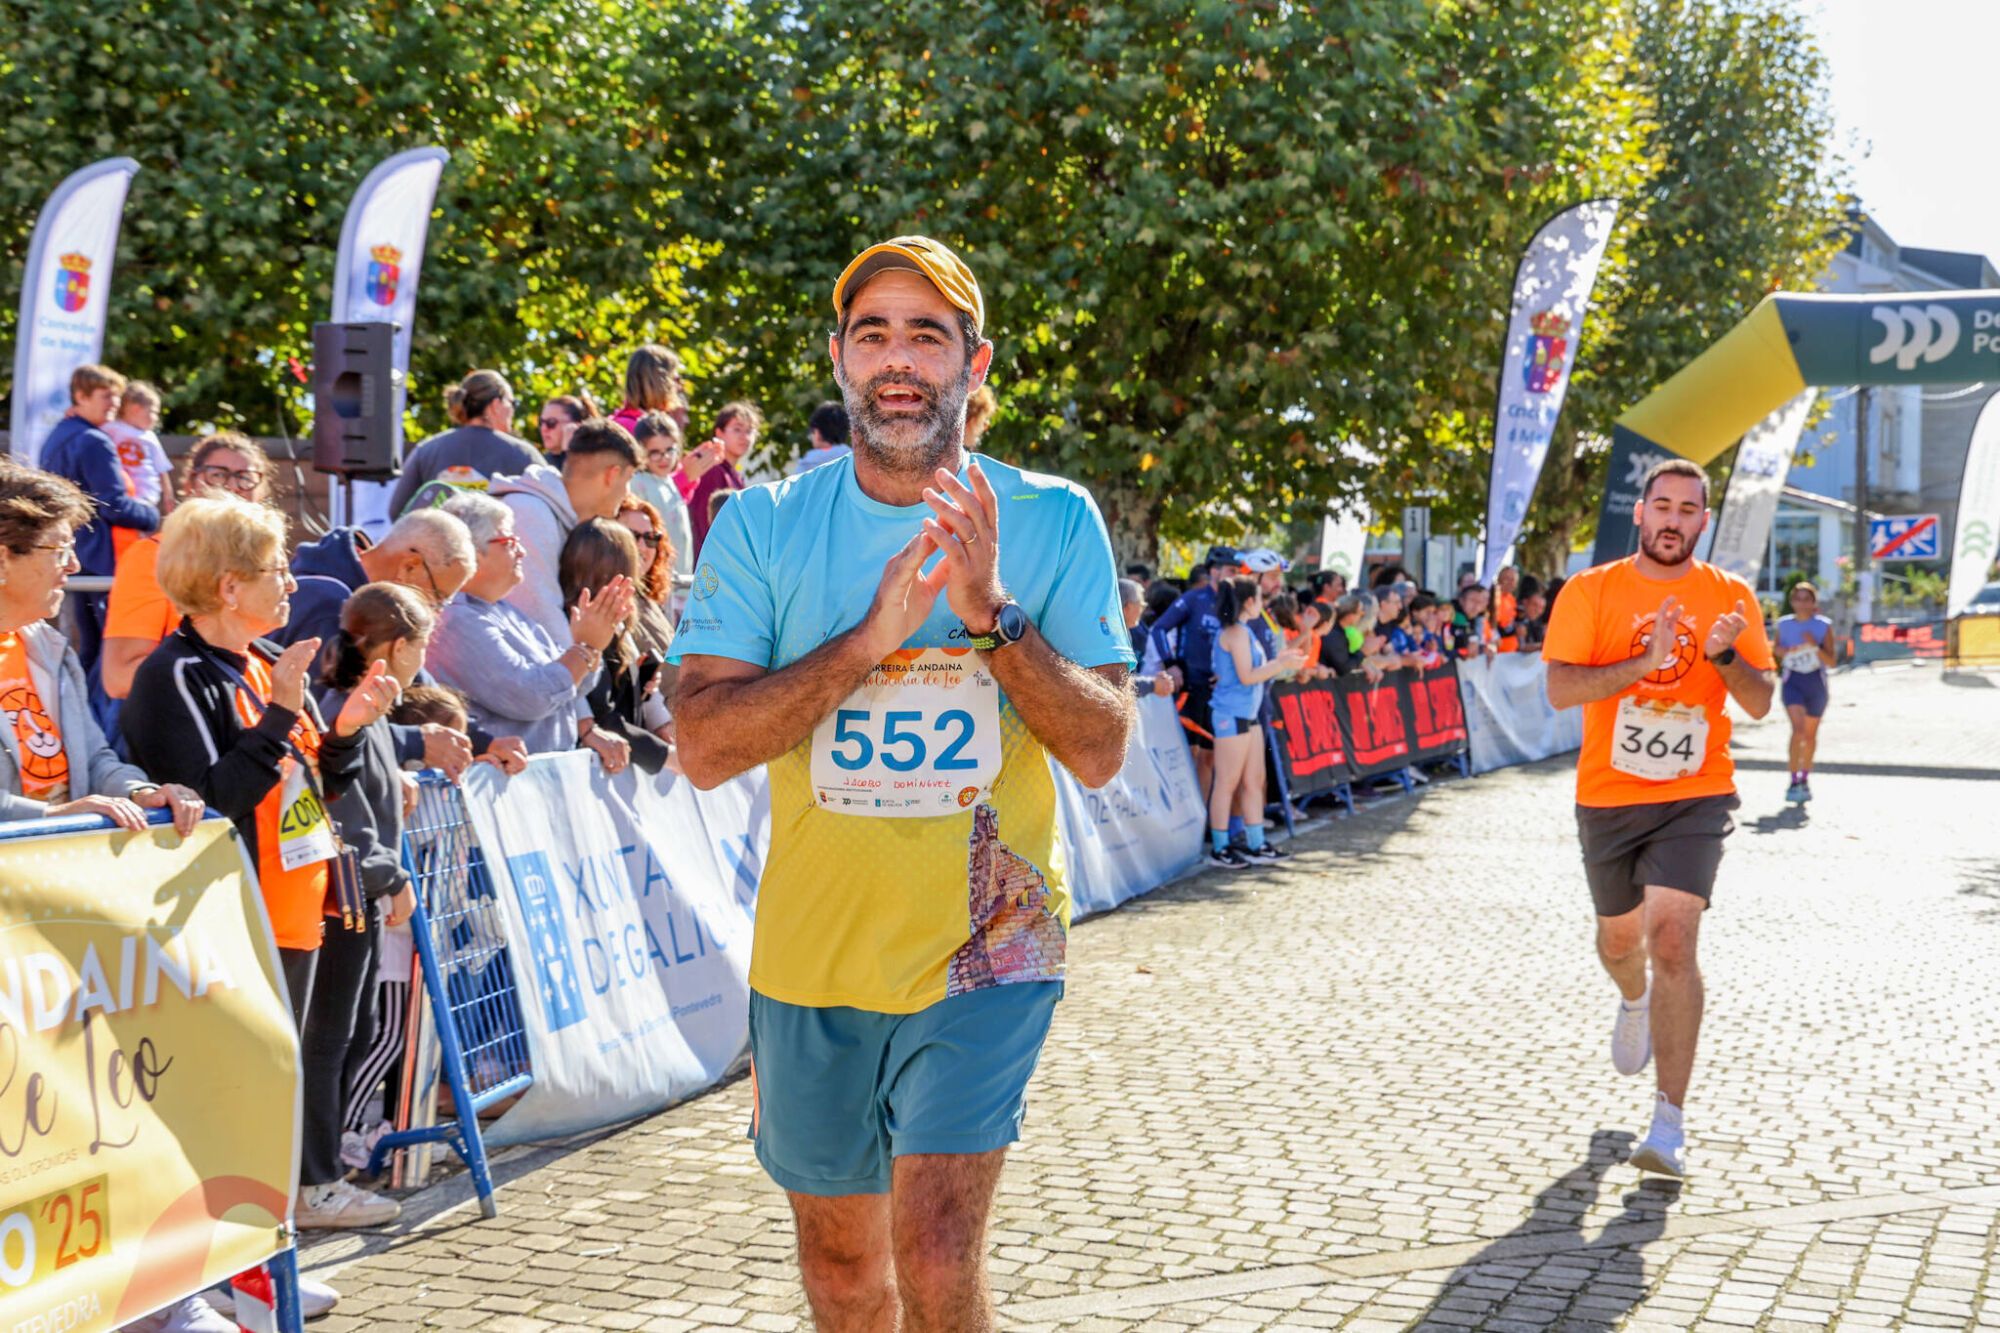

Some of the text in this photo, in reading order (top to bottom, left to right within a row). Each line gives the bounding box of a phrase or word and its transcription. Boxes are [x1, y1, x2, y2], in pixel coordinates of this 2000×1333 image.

[947, 628, 969, 640] CA
[910, 663, 915, 672] E
[917, 663, 963, 672] ANDAINA
[831, 709, 979, 772] 552
[1620, 724, 1695, 762] 364
[83, 1009, 174, 1155] Leo
